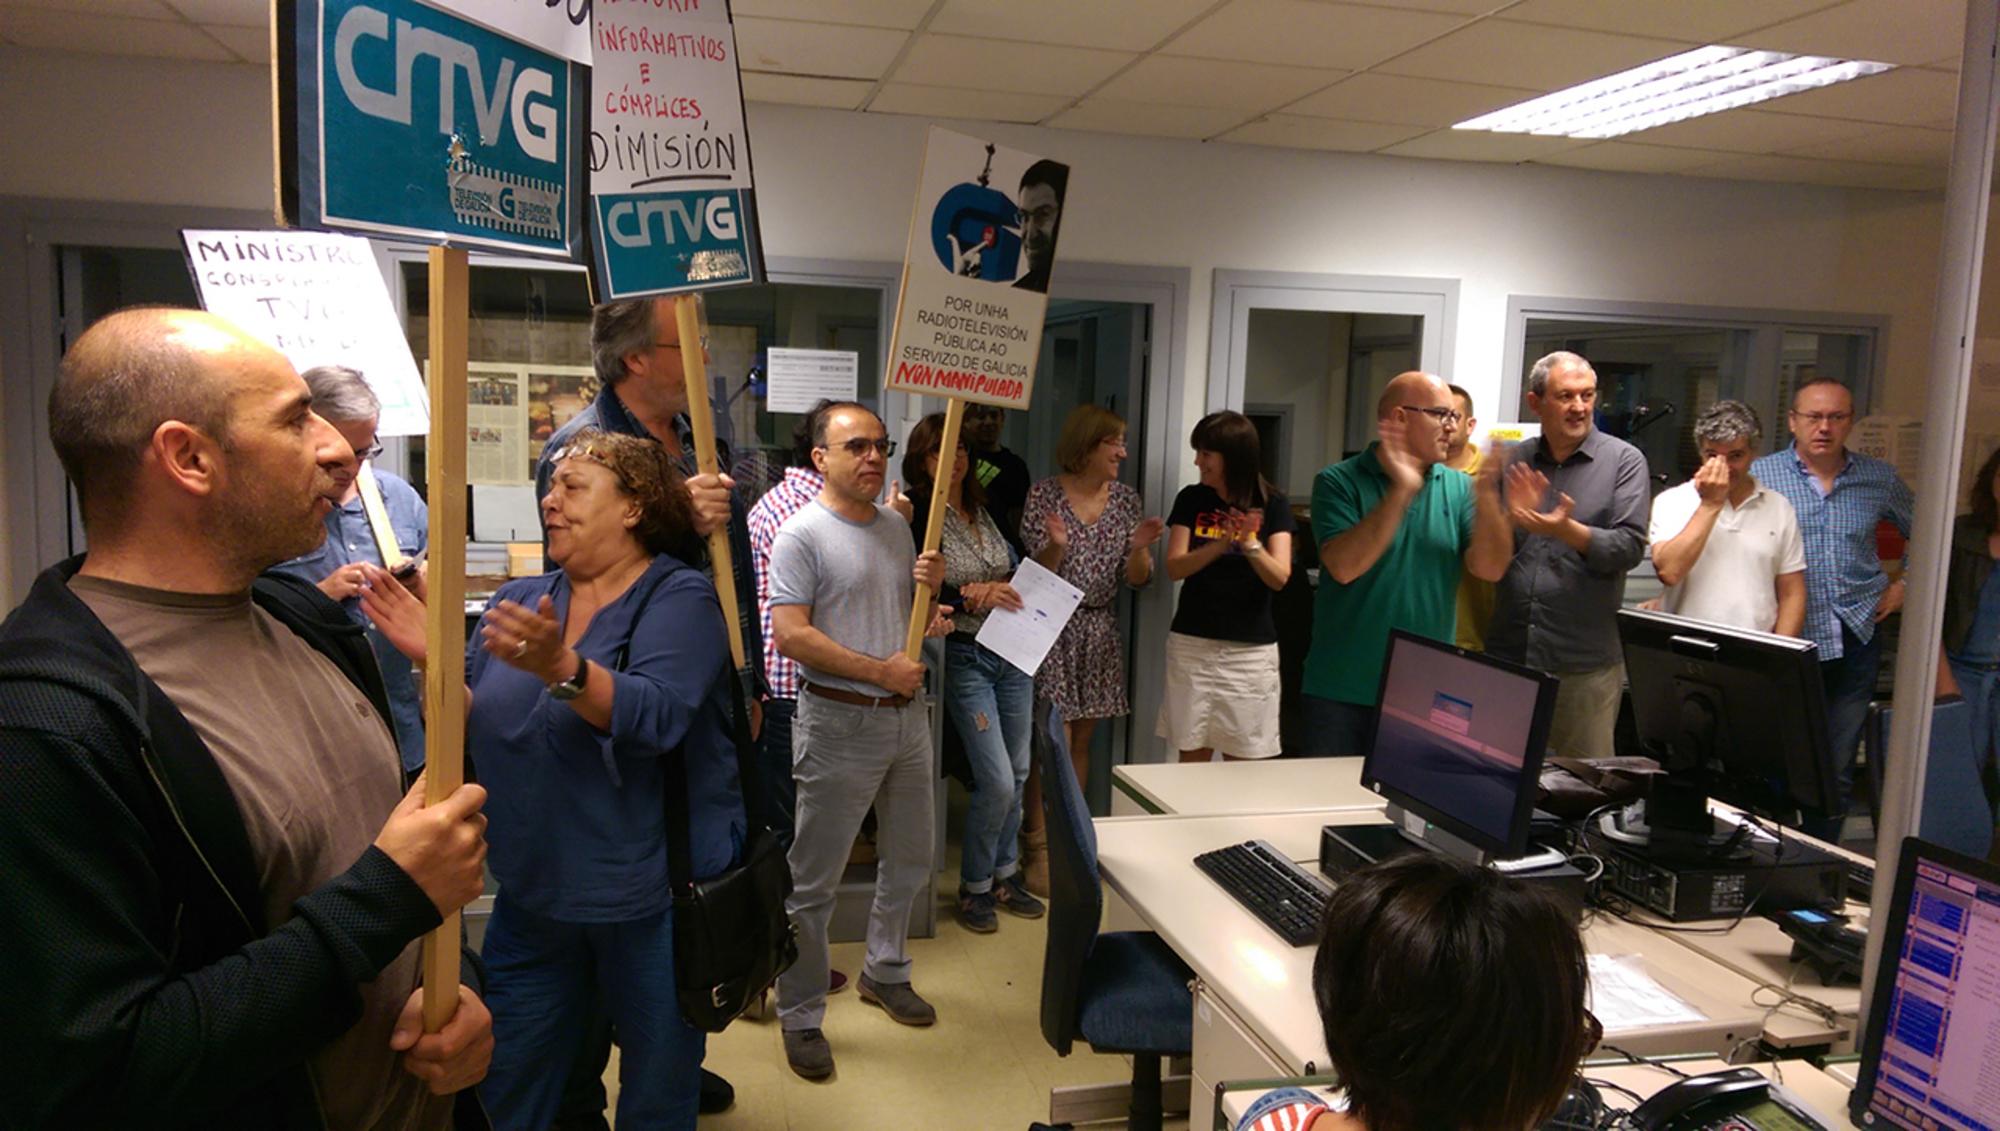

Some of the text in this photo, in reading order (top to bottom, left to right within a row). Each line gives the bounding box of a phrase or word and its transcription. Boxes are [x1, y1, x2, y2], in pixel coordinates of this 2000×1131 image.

[599, 22, 726, 63] INFORMATIVOS
[640, 62, 651, 85] E
[605, 84, 702, 120] CÓMPLICES
[590, 120, 737, 178] DIMISIÓN
[944, 295, 1009, 320] POR UNHA
[917, 310, 1029, 342] RADIOTELEVISIÓN
[933, 331, 1008, 357] PÚBLICA AO
[902, 345, 1029, 378] SERVIZO DE GALICIA
[895, 361, 1024, 400] NON MANIPULADA
